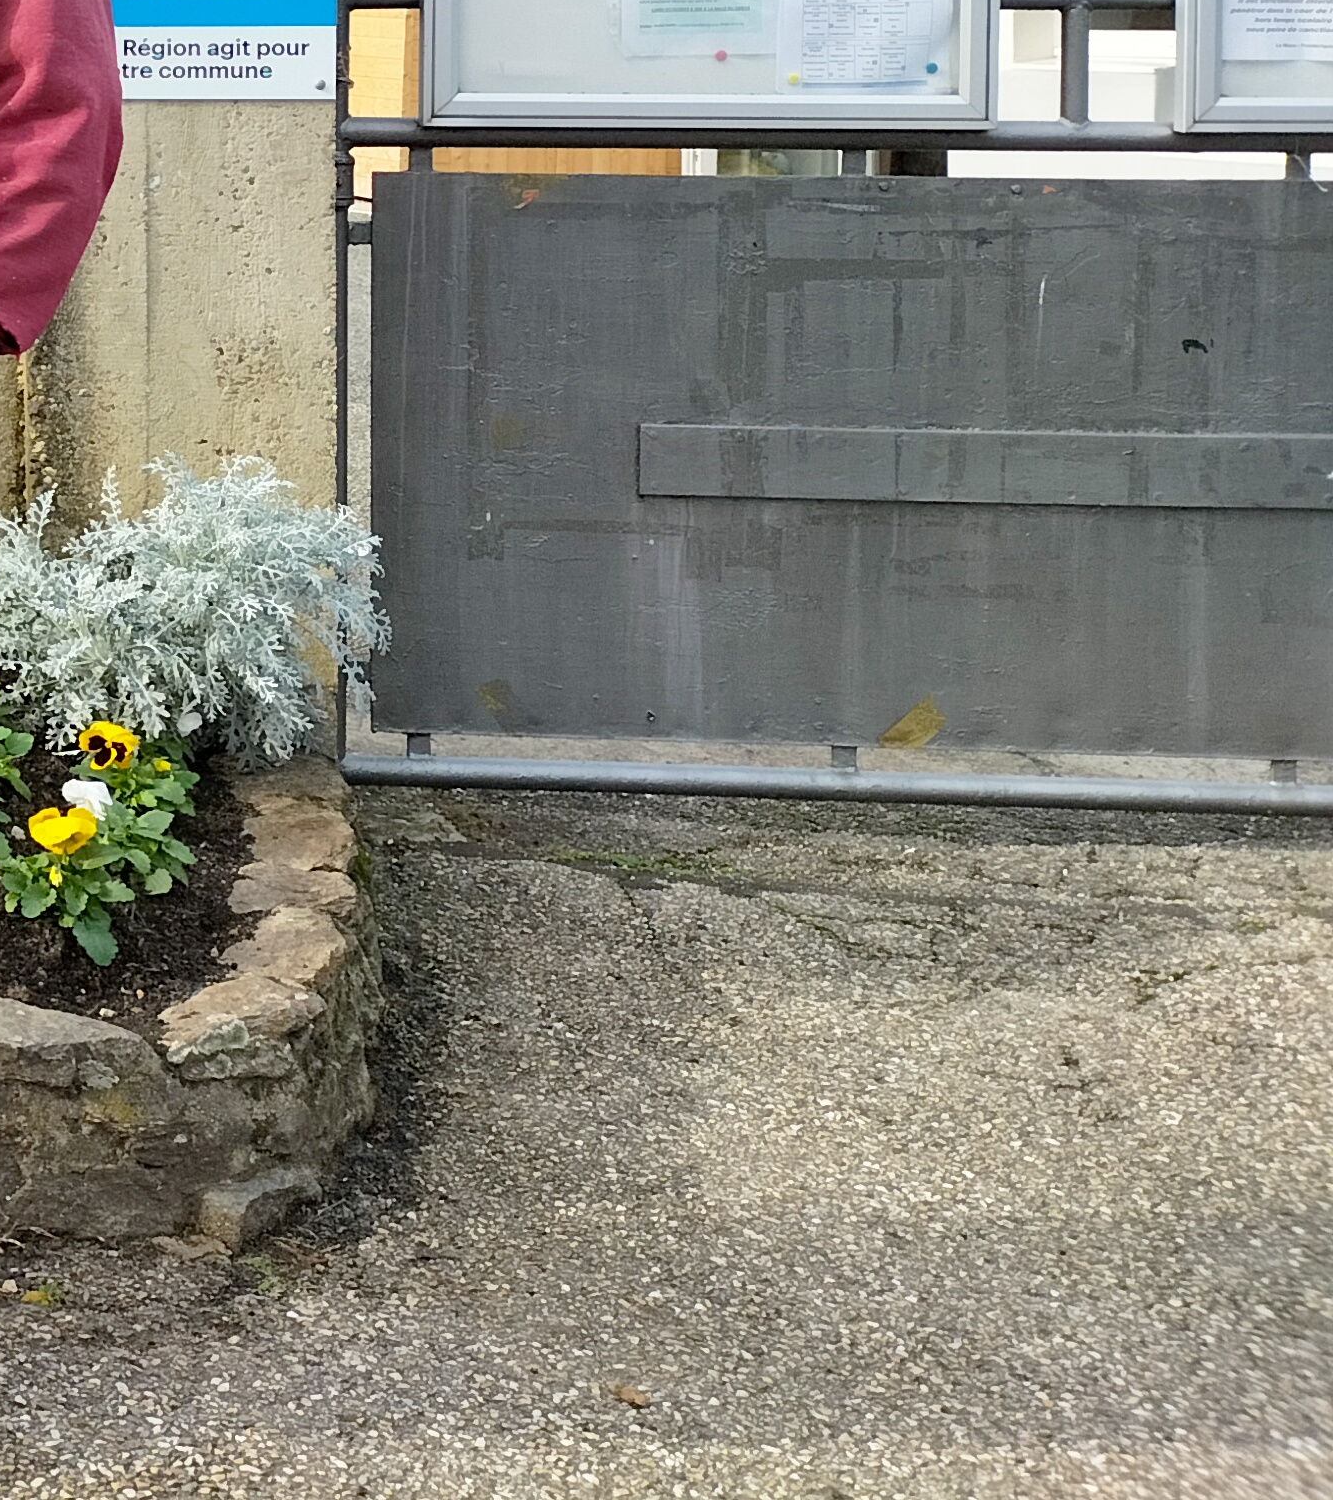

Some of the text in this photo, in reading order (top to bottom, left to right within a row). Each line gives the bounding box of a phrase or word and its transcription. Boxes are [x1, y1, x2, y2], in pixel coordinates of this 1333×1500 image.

[123, 37, 310, 60] Région agit pour
[121, 62, 273, 79] tre commune
